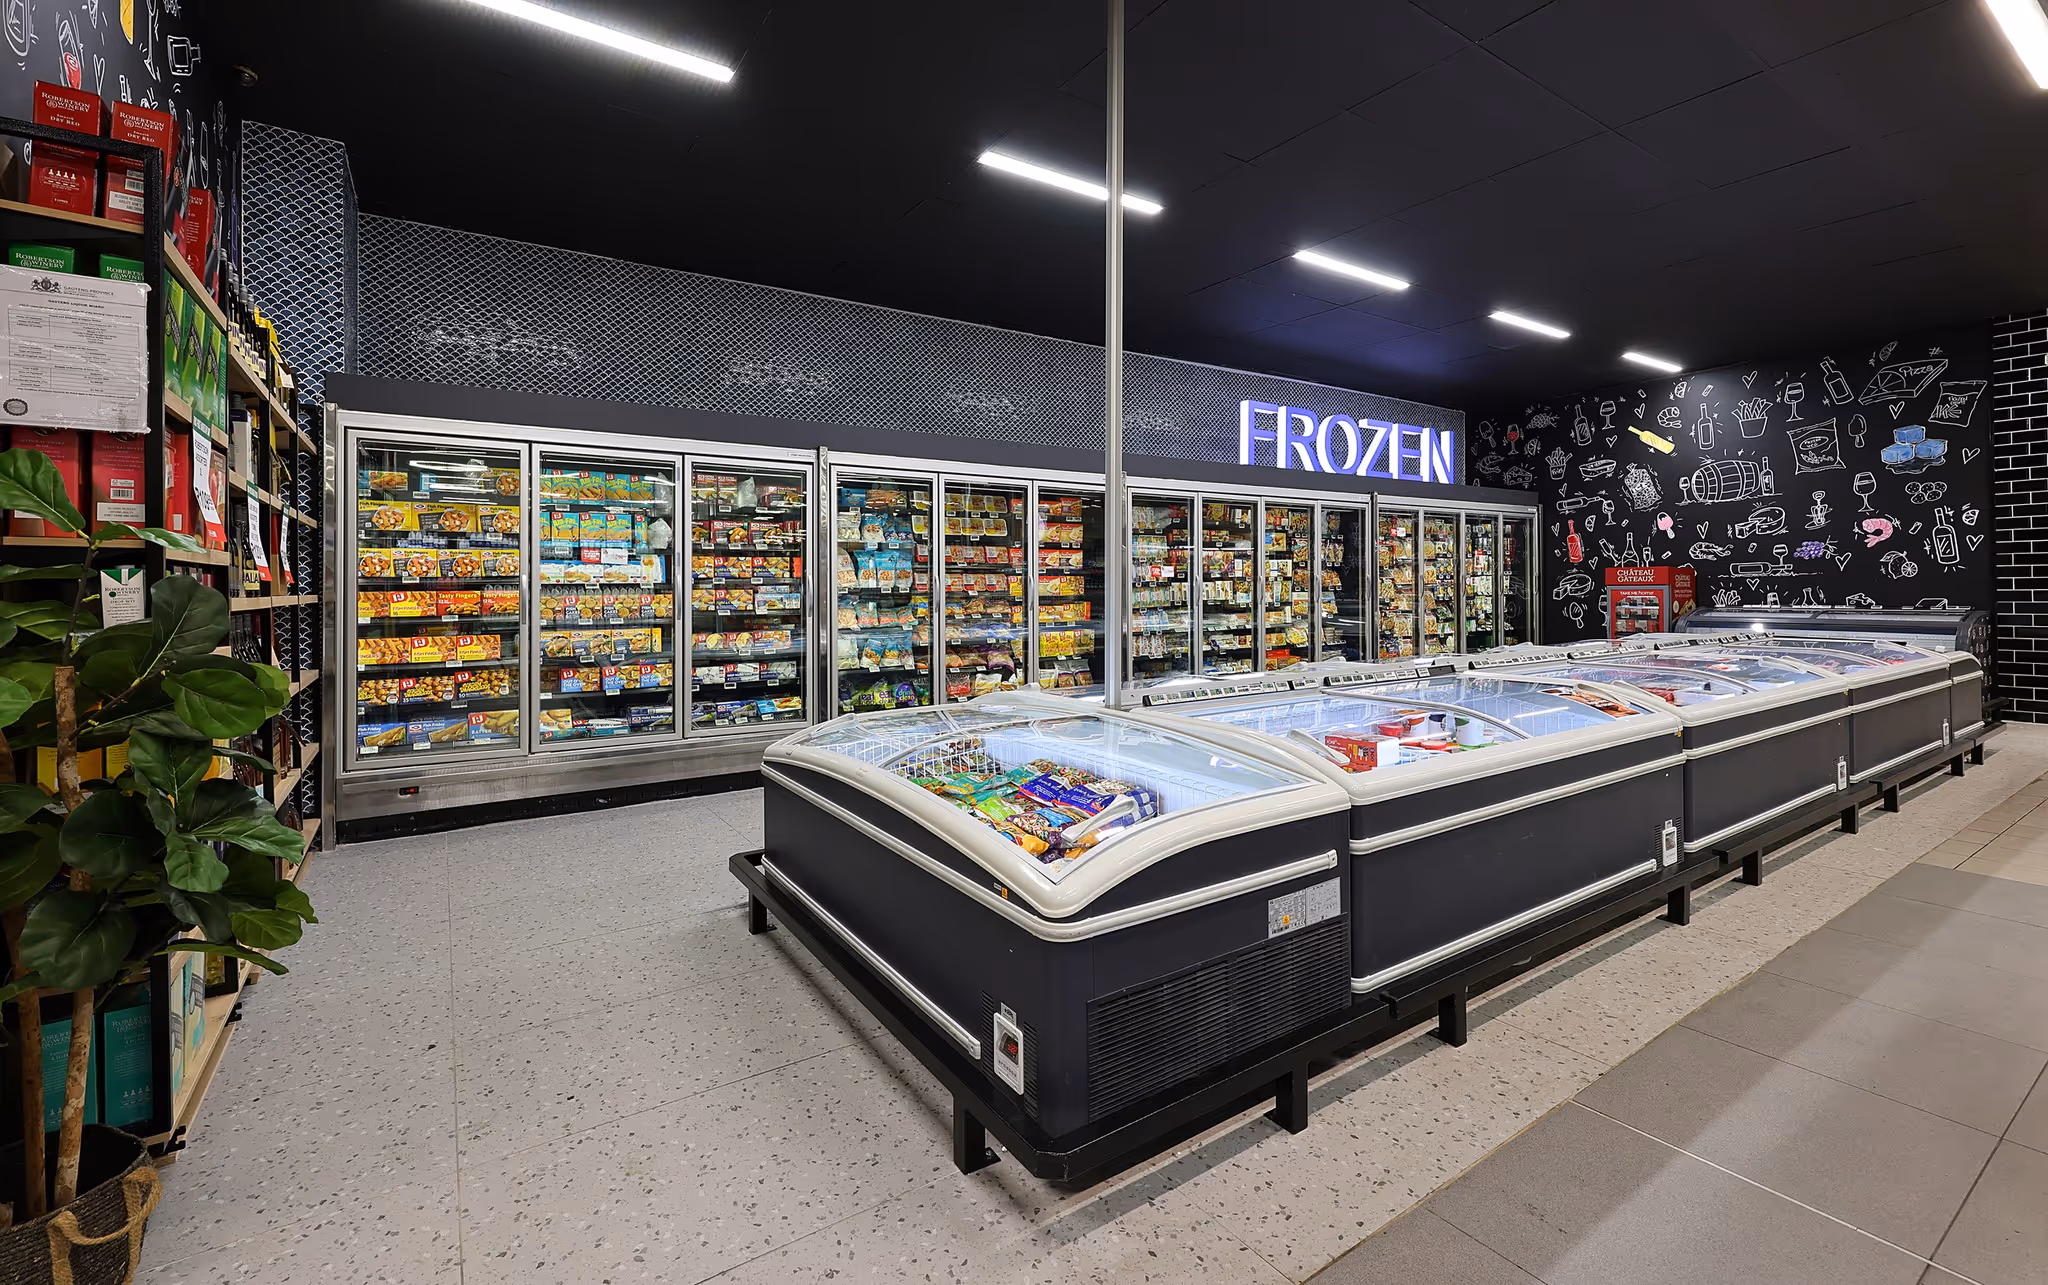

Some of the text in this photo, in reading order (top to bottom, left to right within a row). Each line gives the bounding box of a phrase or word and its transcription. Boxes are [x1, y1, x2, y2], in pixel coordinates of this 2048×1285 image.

[42, 92, 90, 108] ROBERTSON
[57, 101, 90, 112] WINERY
[120, 112, 164, 128] ROBERTSON
[134, 120, 163, 132] WINERY
[16, 252, 64, 266] ROBERTSON
[32, 260, 64, 268] WINERY
[1899, 365, 1934, 376] Pizza
[1240, 400, 1454, 484] FROZEN
